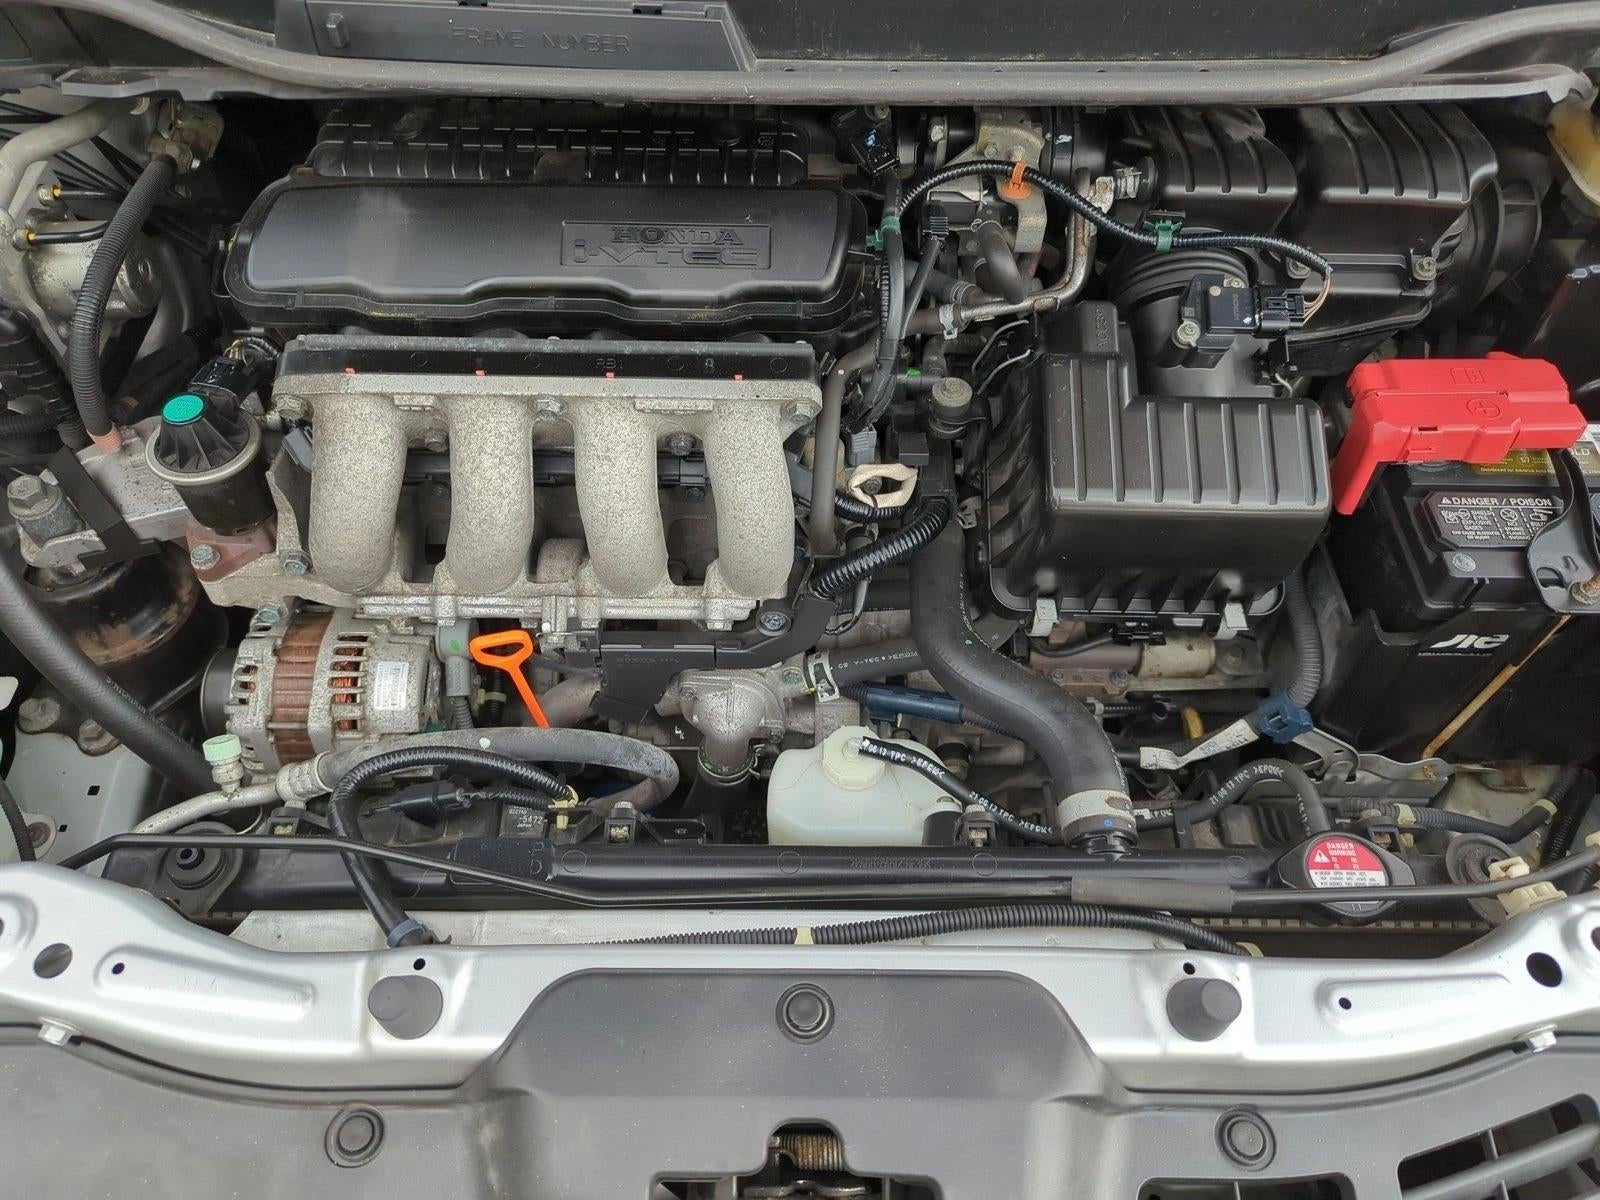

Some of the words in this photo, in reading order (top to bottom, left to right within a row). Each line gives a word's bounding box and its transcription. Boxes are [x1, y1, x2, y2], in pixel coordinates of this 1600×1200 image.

[452, 26, 526, 49] FRAME
[542, 31, 632, 53] NUMBER
[611, 226, 744, 246] HONDA
[1452, 496, 1499, 506] DANGER
[1510, 498, 1552, 506] POISON
[890, 750, 907, 762] TPC
[1234, 769, 1251, 785] TPC
[999, 808, 1015, 823] TPC
[1326, 842, 1355, 850] DANGER
[1328, 849, 1357, 857] WARNING
